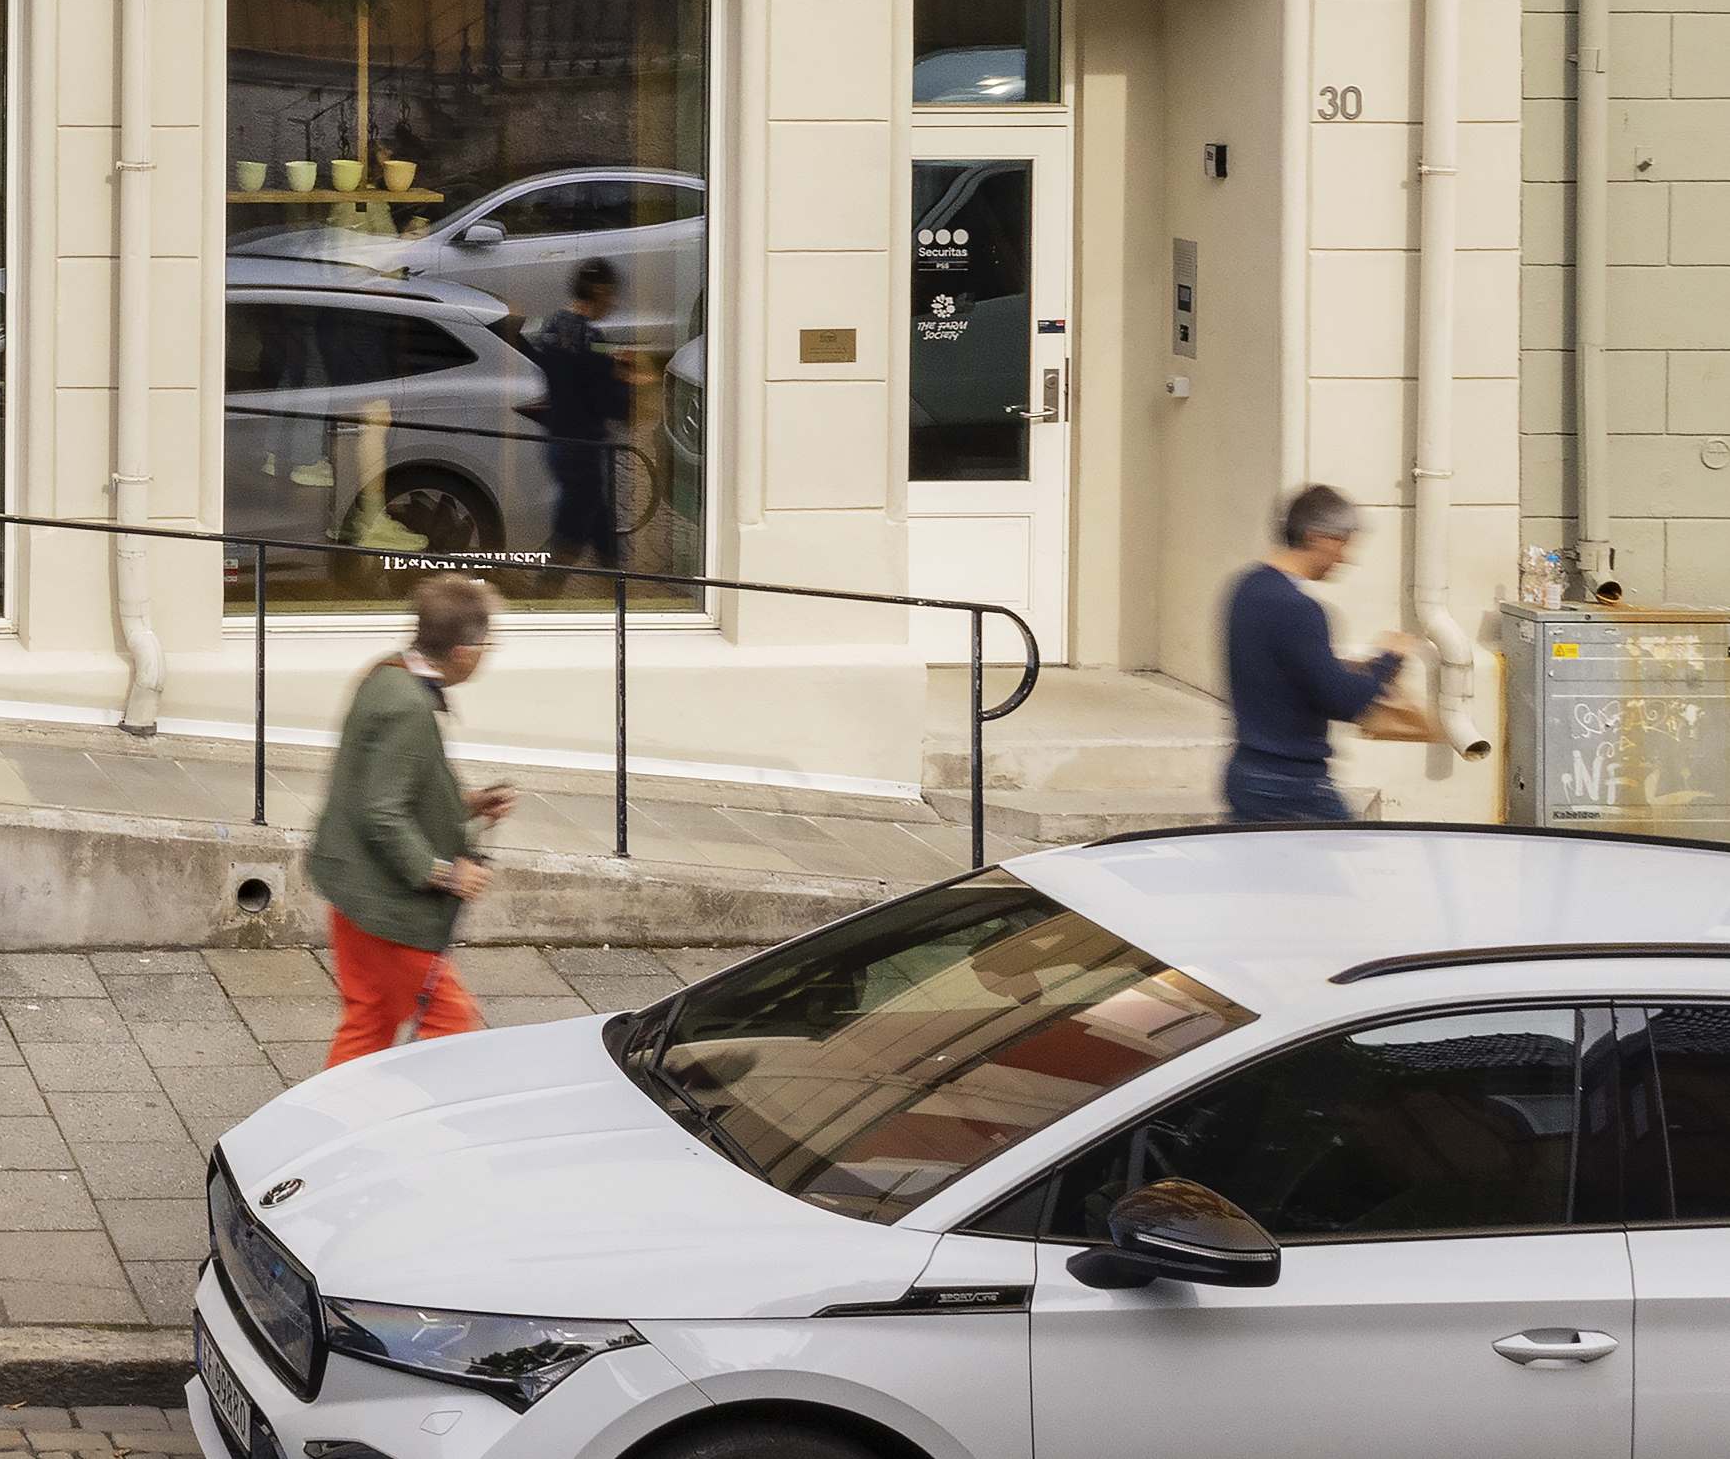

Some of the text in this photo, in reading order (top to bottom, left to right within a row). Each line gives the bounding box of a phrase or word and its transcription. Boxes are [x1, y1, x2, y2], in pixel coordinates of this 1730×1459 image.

[1317, 85, 1363, 121] 30
[918, 247, 968, 258] Securitas
[917, 322, 937, 332] THE
[1552, 810, 1602, 820] Kabeldon
[214, 1361, 247, 1437] 99880
